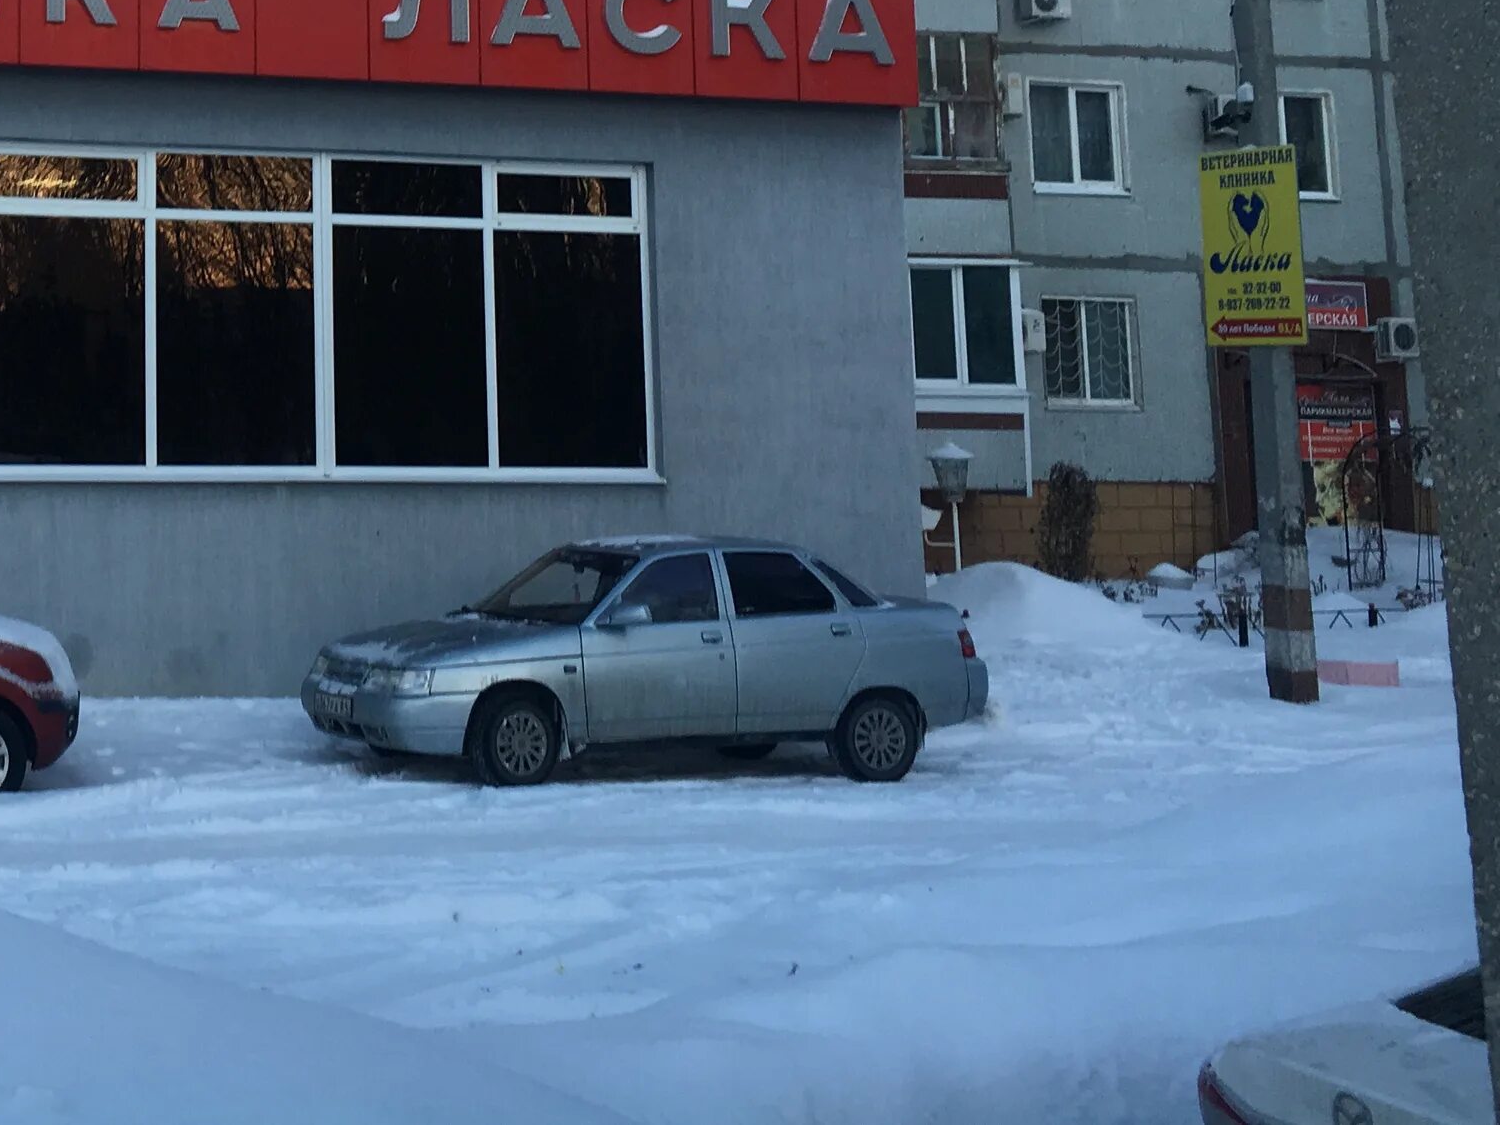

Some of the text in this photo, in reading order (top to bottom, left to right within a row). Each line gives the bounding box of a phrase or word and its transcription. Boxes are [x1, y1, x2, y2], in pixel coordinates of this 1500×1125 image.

[1201, 148, 1293, 171] ВЕТЕРИНАРНАЯ
[1219, 170, 1275, 188] КЛИНИКА
[1209, 241, 1292, 274] Ласка
[1242, 281, 1281, 295] 32-32-00
[1307, 312, 1358, 326] ЕРСКАЯ
[1243, 323, 1276, 334] Победы
